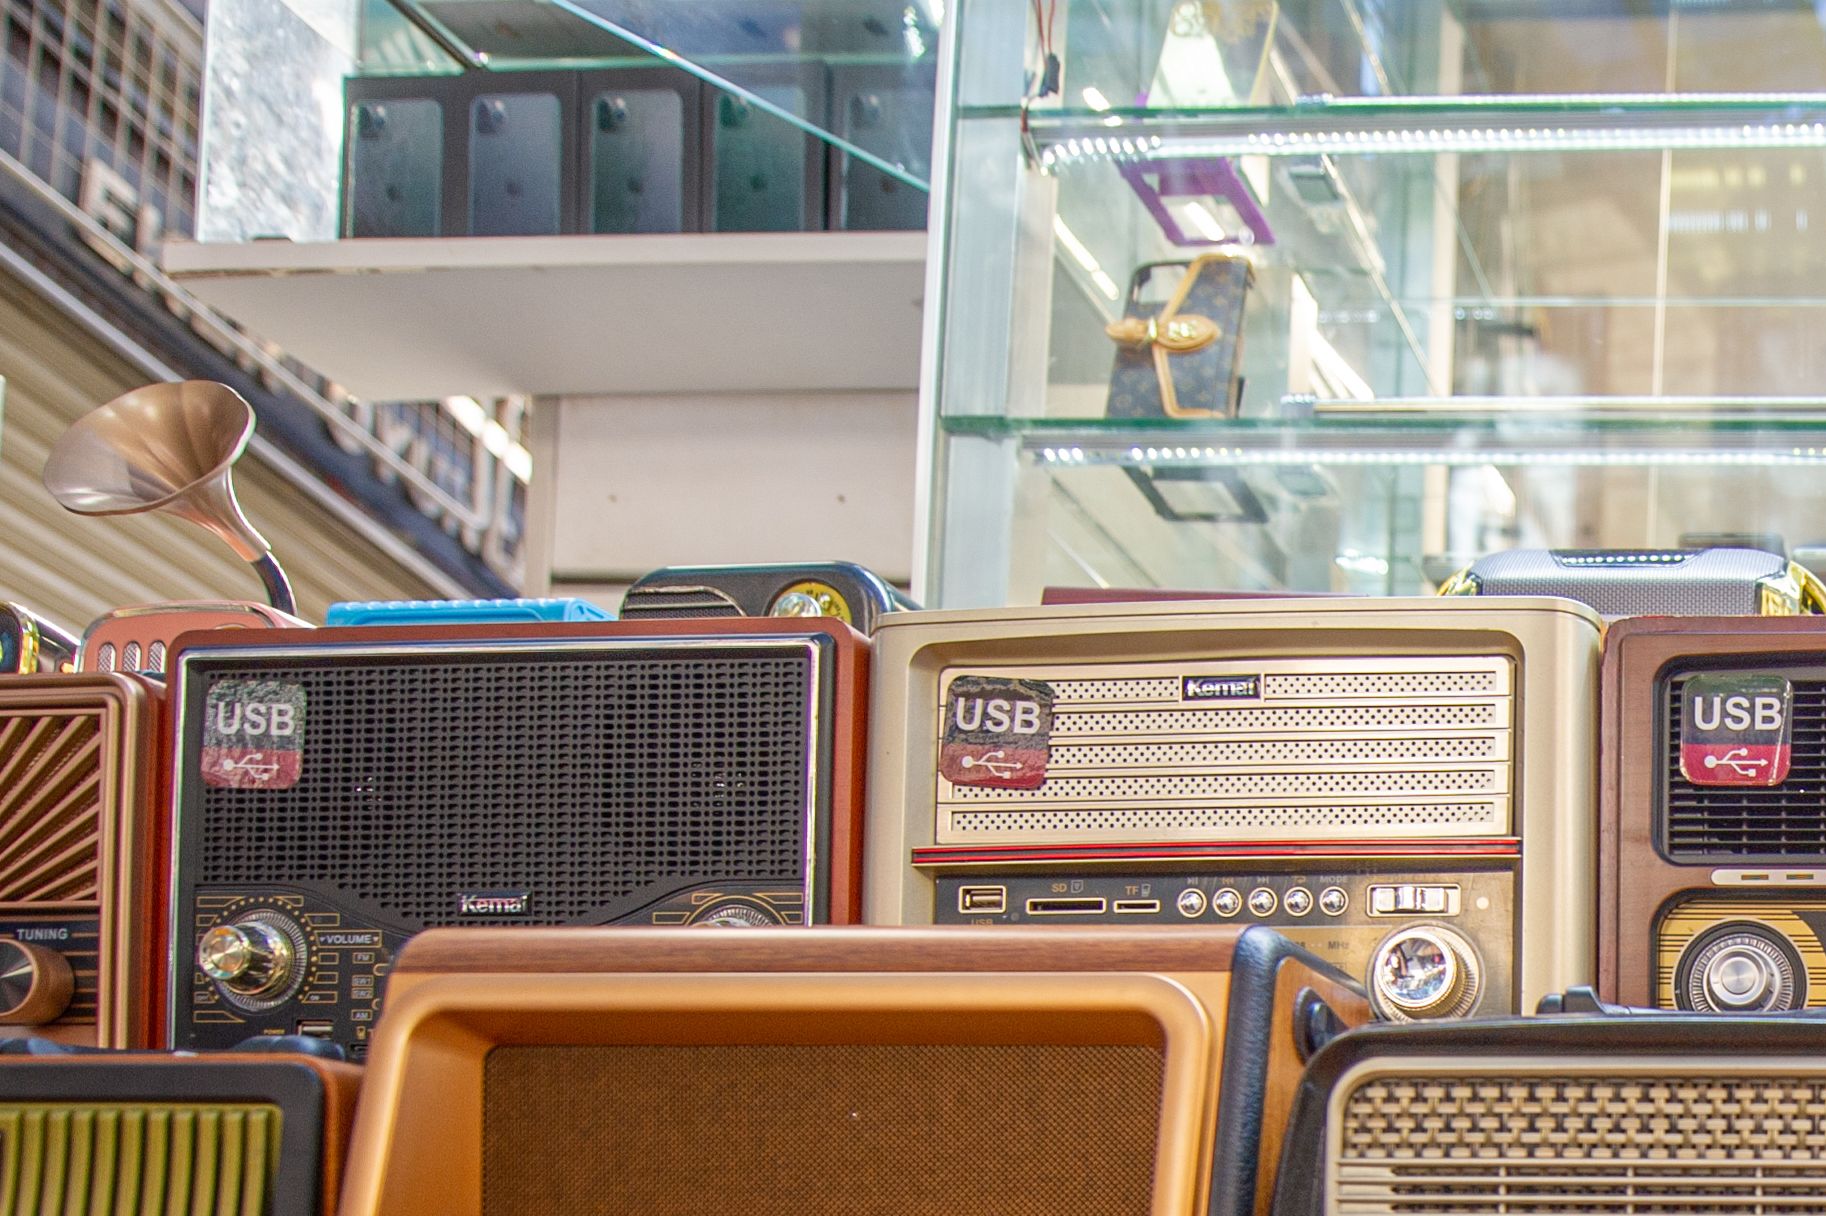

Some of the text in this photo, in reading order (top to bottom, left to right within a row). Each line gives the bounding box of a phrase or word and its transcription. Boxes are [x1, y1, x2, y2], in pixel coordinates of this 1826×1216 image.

[217, 702, 295, 735] USB
[956, 697, 1040, 734] USB
[1694, 697, 1782, 731] USB
[1052, 884, 1067, 893] SD
[1125, 886, 1139, 895] TF
[462, 895, 528, 912] Kemai
[17, 928, 68, 940] TUNING
[327, 935, 371, 943] VOLUME
